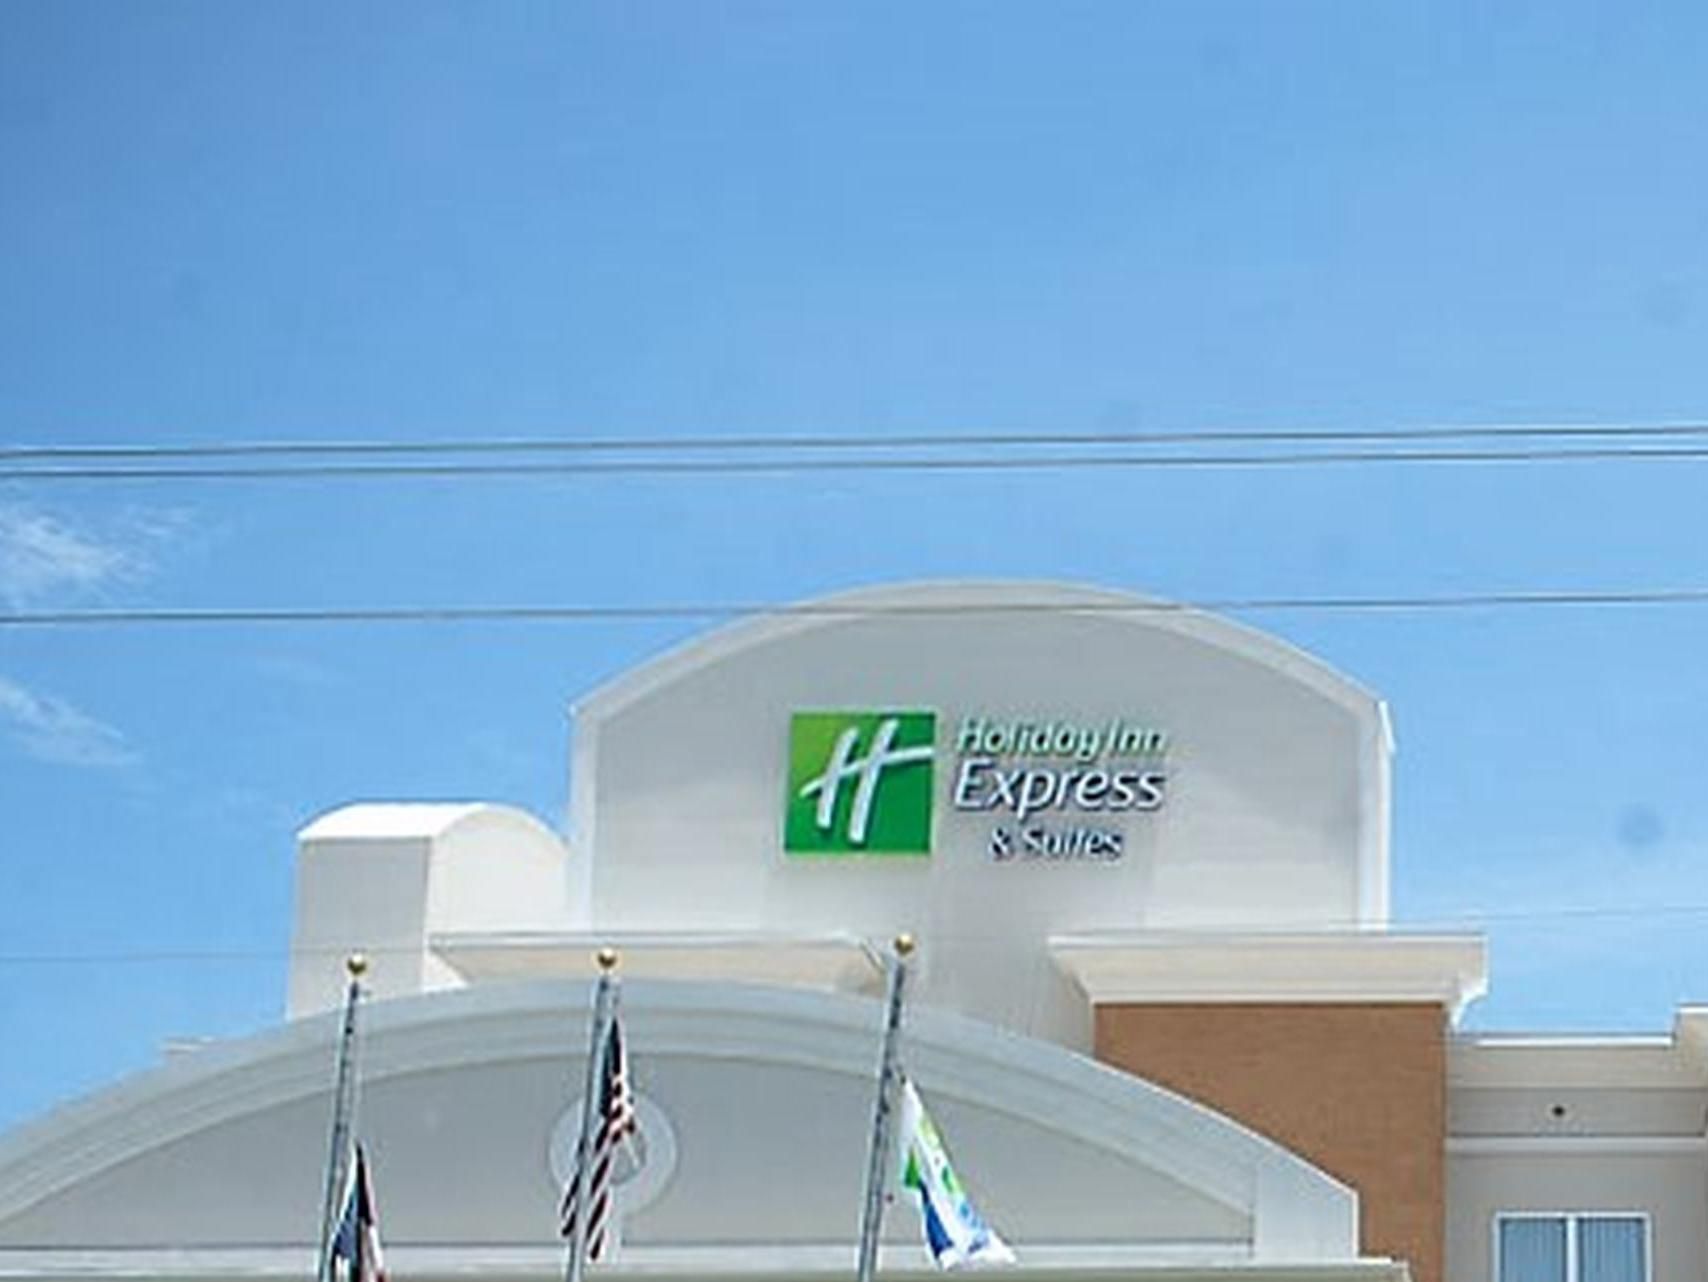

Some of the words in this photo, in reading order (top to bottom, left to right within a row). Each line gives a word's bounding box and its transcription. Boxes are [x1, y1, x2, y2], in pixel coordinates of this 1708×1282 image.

[957, 717, 1099, 762] Holiday
[1105, 720, 1168, 753] Inn
[954, 757, 1166, 820] Express
[990, 829, 1012, 860] &
[1023, 827, 1124, 860] Suites
